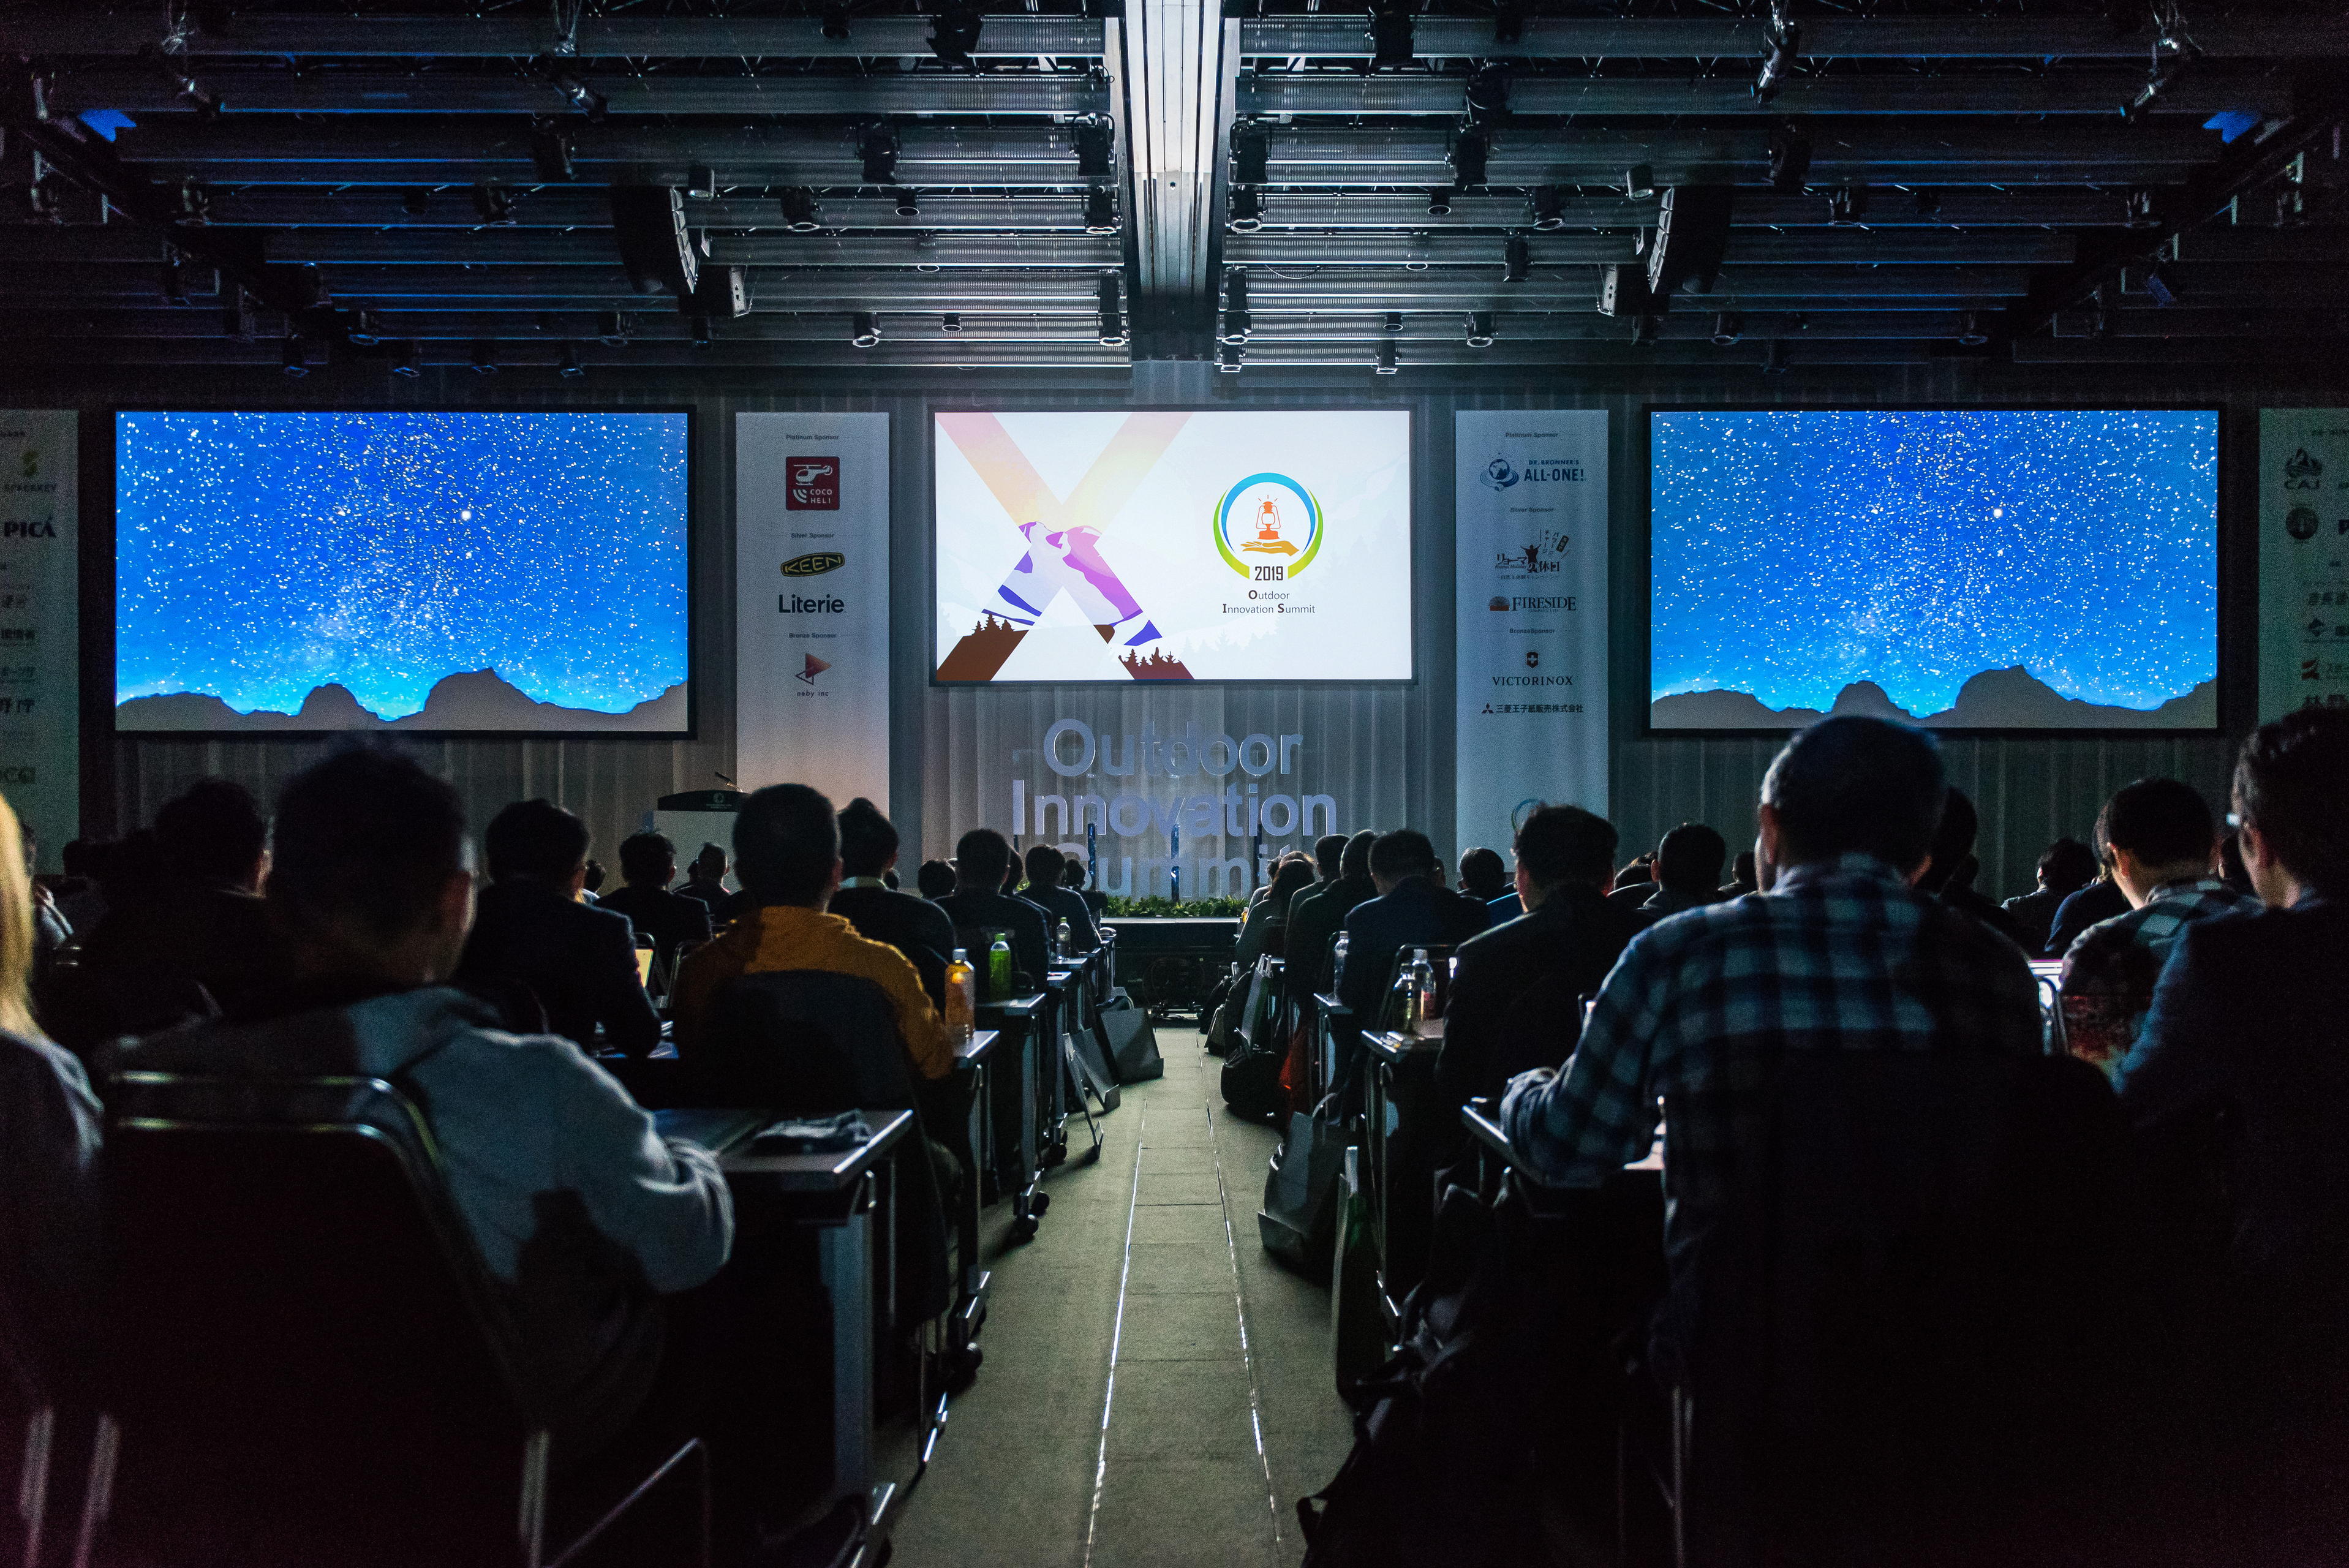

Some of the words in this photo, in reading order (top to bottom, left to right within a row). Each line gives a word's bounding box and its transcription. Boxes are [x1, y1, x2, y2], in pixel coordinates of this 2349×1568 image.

[1524, 469, 1584, 481] ALL-ONE!
[785, 556, 841, 573] KEEN
[1254, 566, 1283, 581] 2019
[1248, 589, 1290, 600] Outdoor
[779, 594, 845, 613] Literie
[1223, 603, 1274, 613] Innovation
[1278, 603, 1316, 613] Summit
[1512, 597, 1577, 611] FIRESIDE
[1492, 676, 1573, 686] VICTORINOX
[796, 689, 815, 698] neby
[1496, 704, 1584, 713] 三菱王子紙販売株式会社
[1044, 718, 1303, 777] Outdoor
[1012, 779, 1337, 837] Innovation
